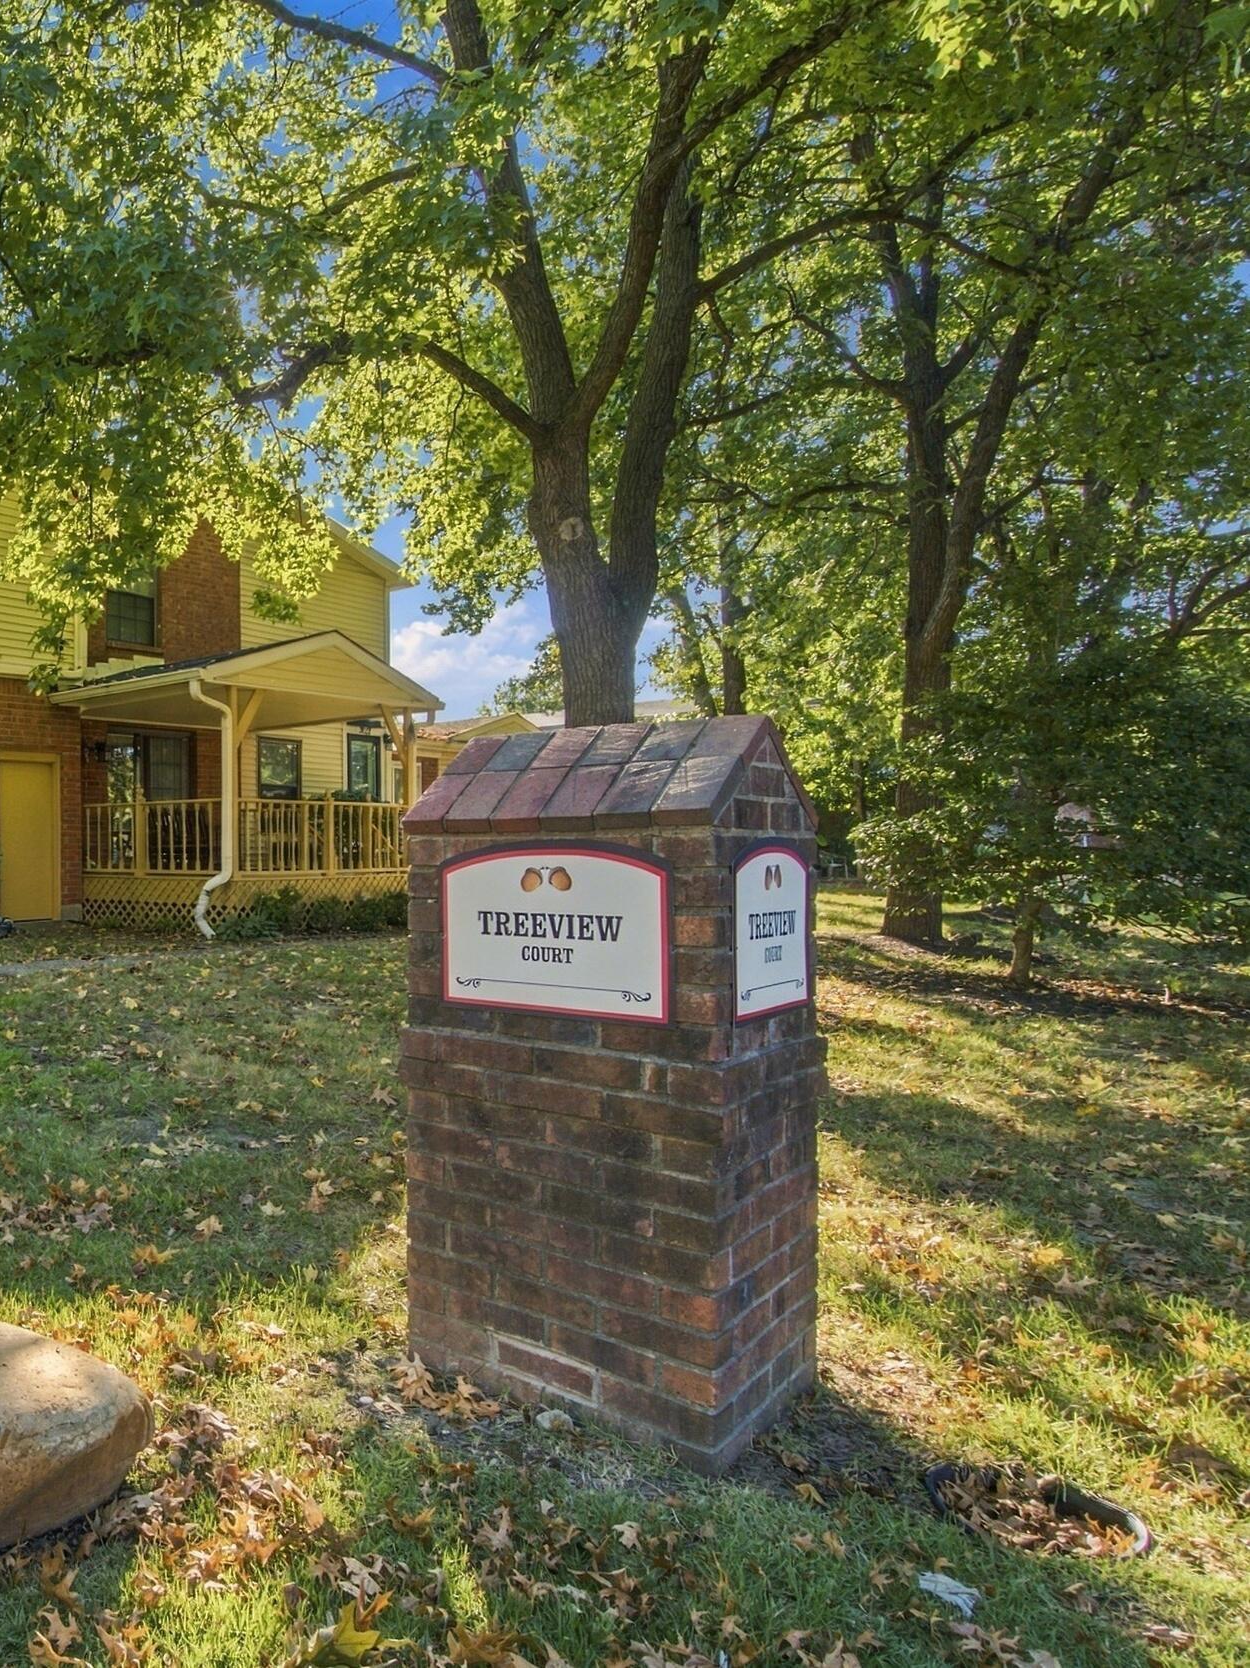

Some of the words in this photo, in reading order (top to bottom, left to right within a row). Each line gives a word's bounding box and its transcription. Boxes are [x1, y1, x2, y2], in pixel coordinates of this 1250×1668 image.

[477, 910, 623, 942] TREEVIEW
[748, 909, 797, 940] TREEVIEW
[521, 945, 574, 964] COURT
[764, 945, 783, 964] COURT
